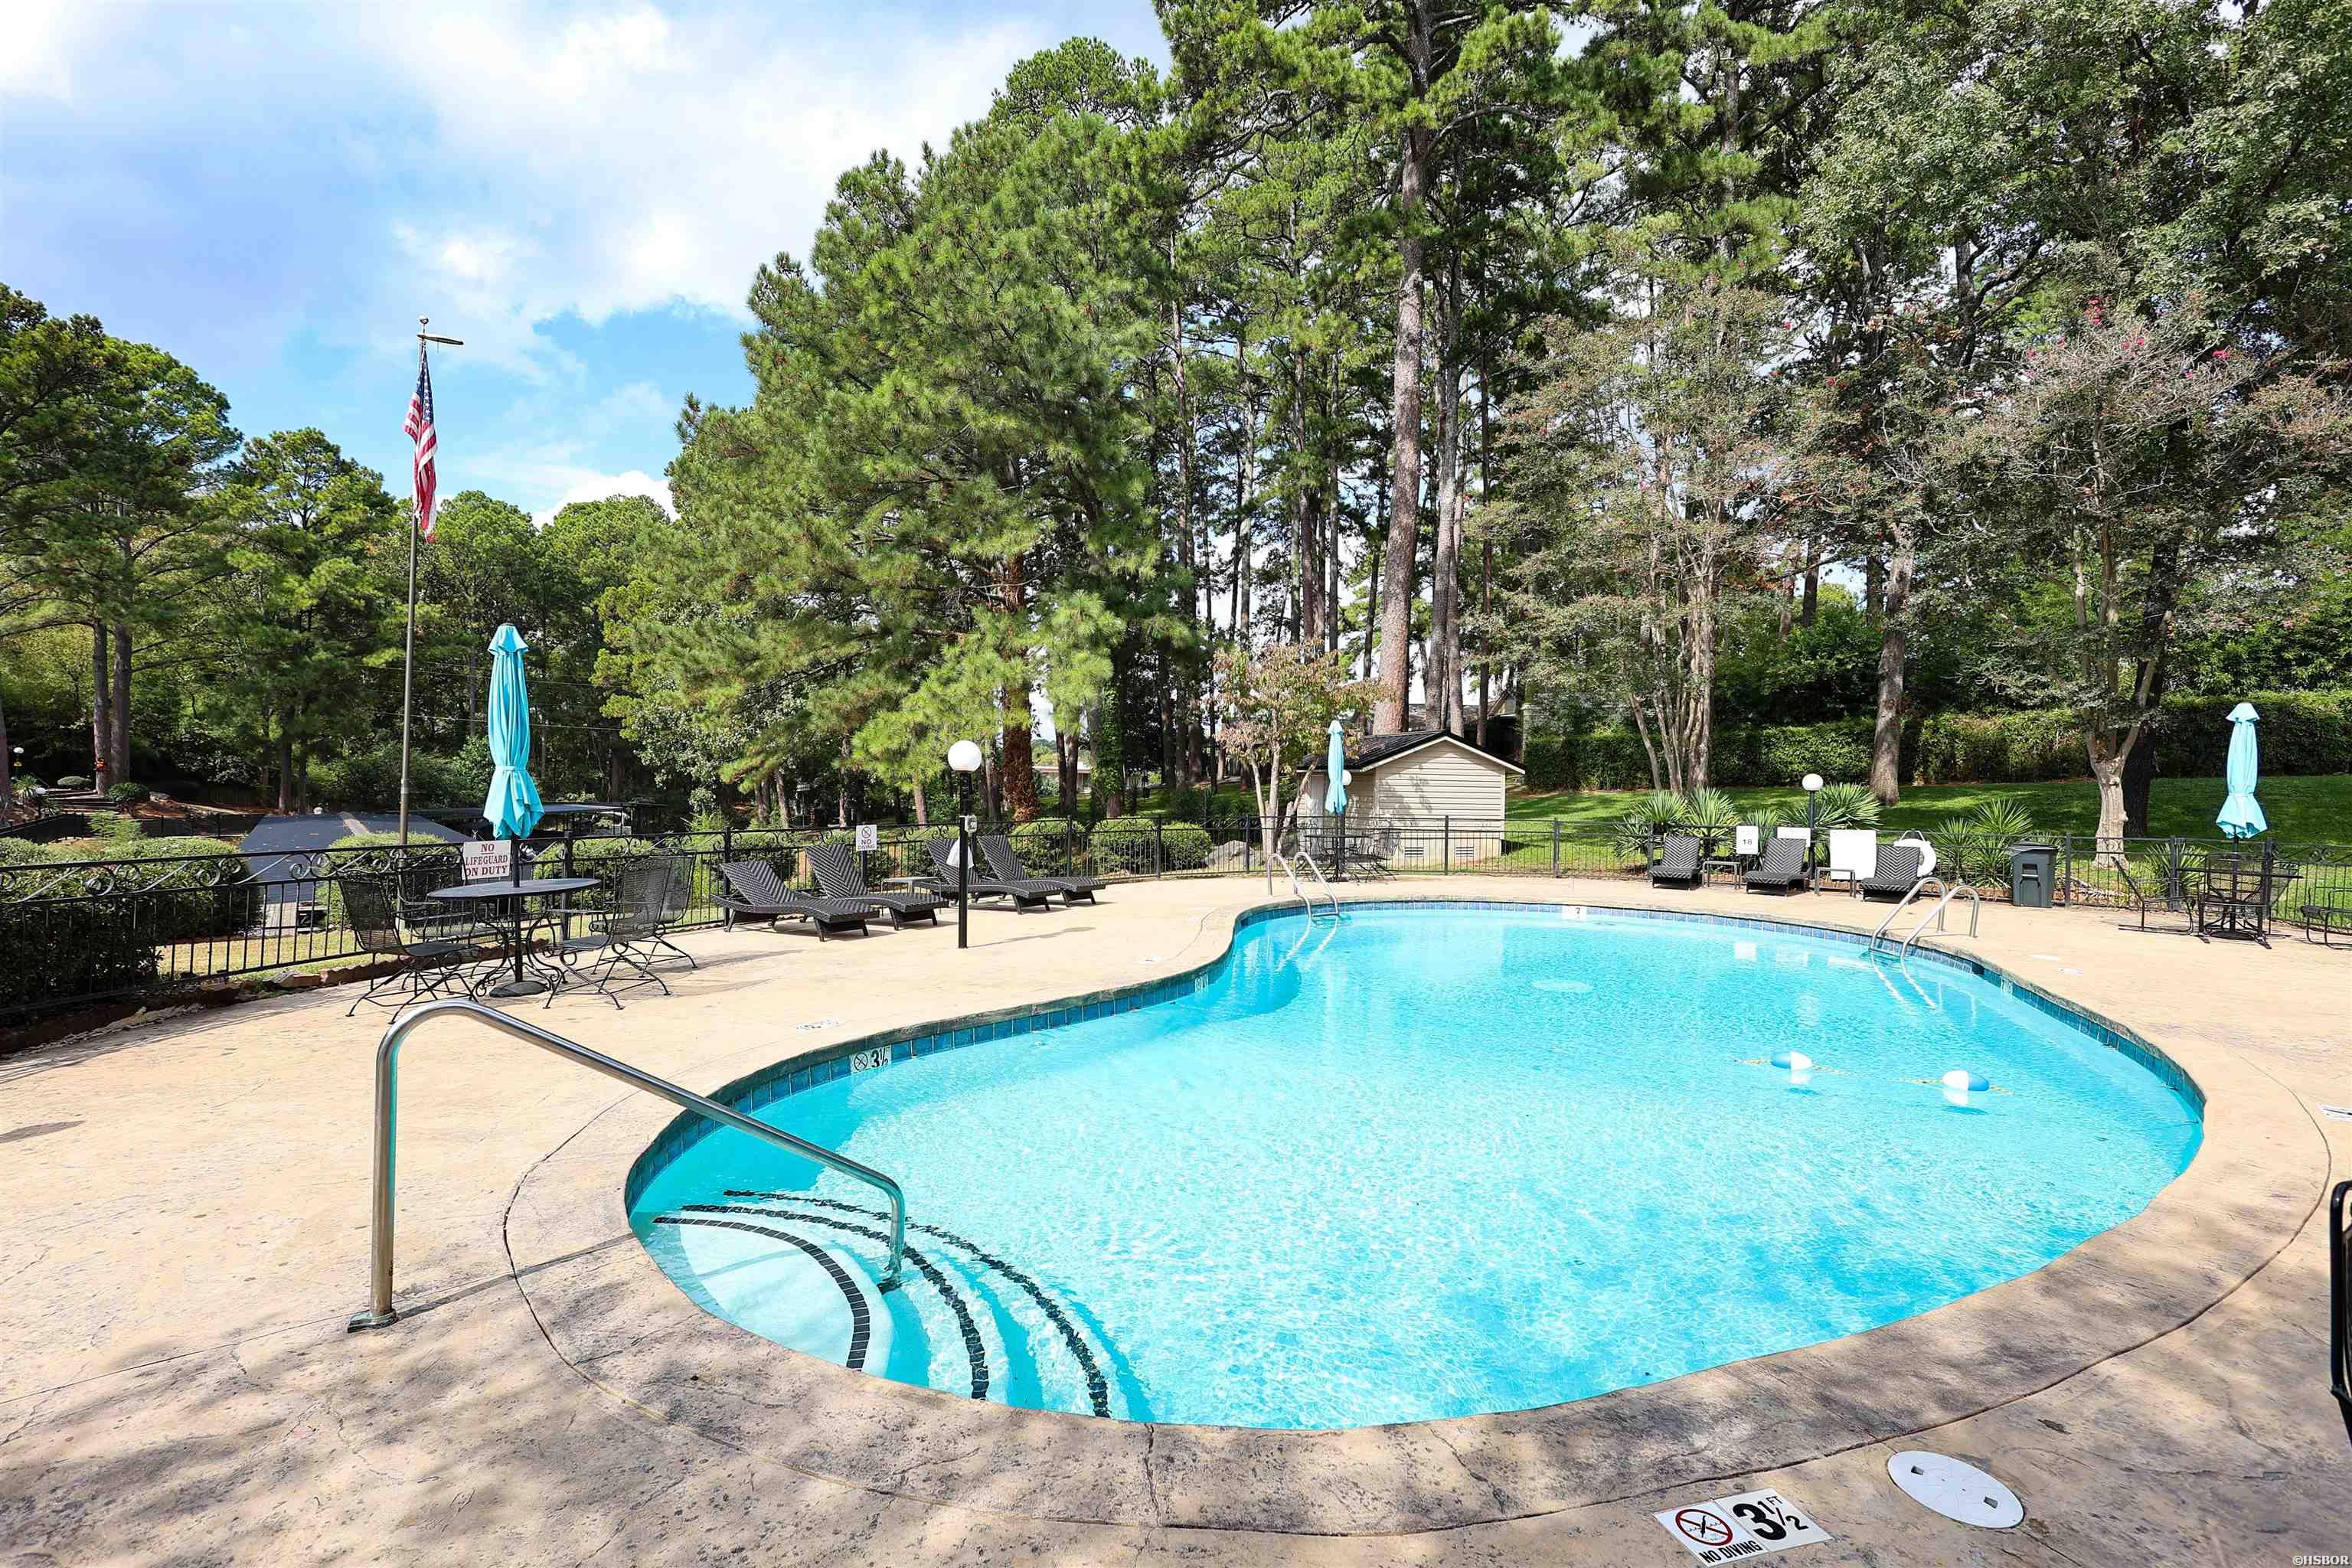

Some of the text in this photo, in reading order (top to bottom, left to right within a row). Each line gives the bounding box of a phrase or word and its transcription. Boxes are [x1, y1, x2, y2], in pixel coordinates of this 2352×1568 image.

[481, 843, 495, 853] NO
[465, 854, 508, 866] LIFEGUARD
[466, 865, 508, 877] ON DUTY
[1766, 1495, 1785, 1505] FT
[1698, 1540, 1763, 1564] NO DIVING
